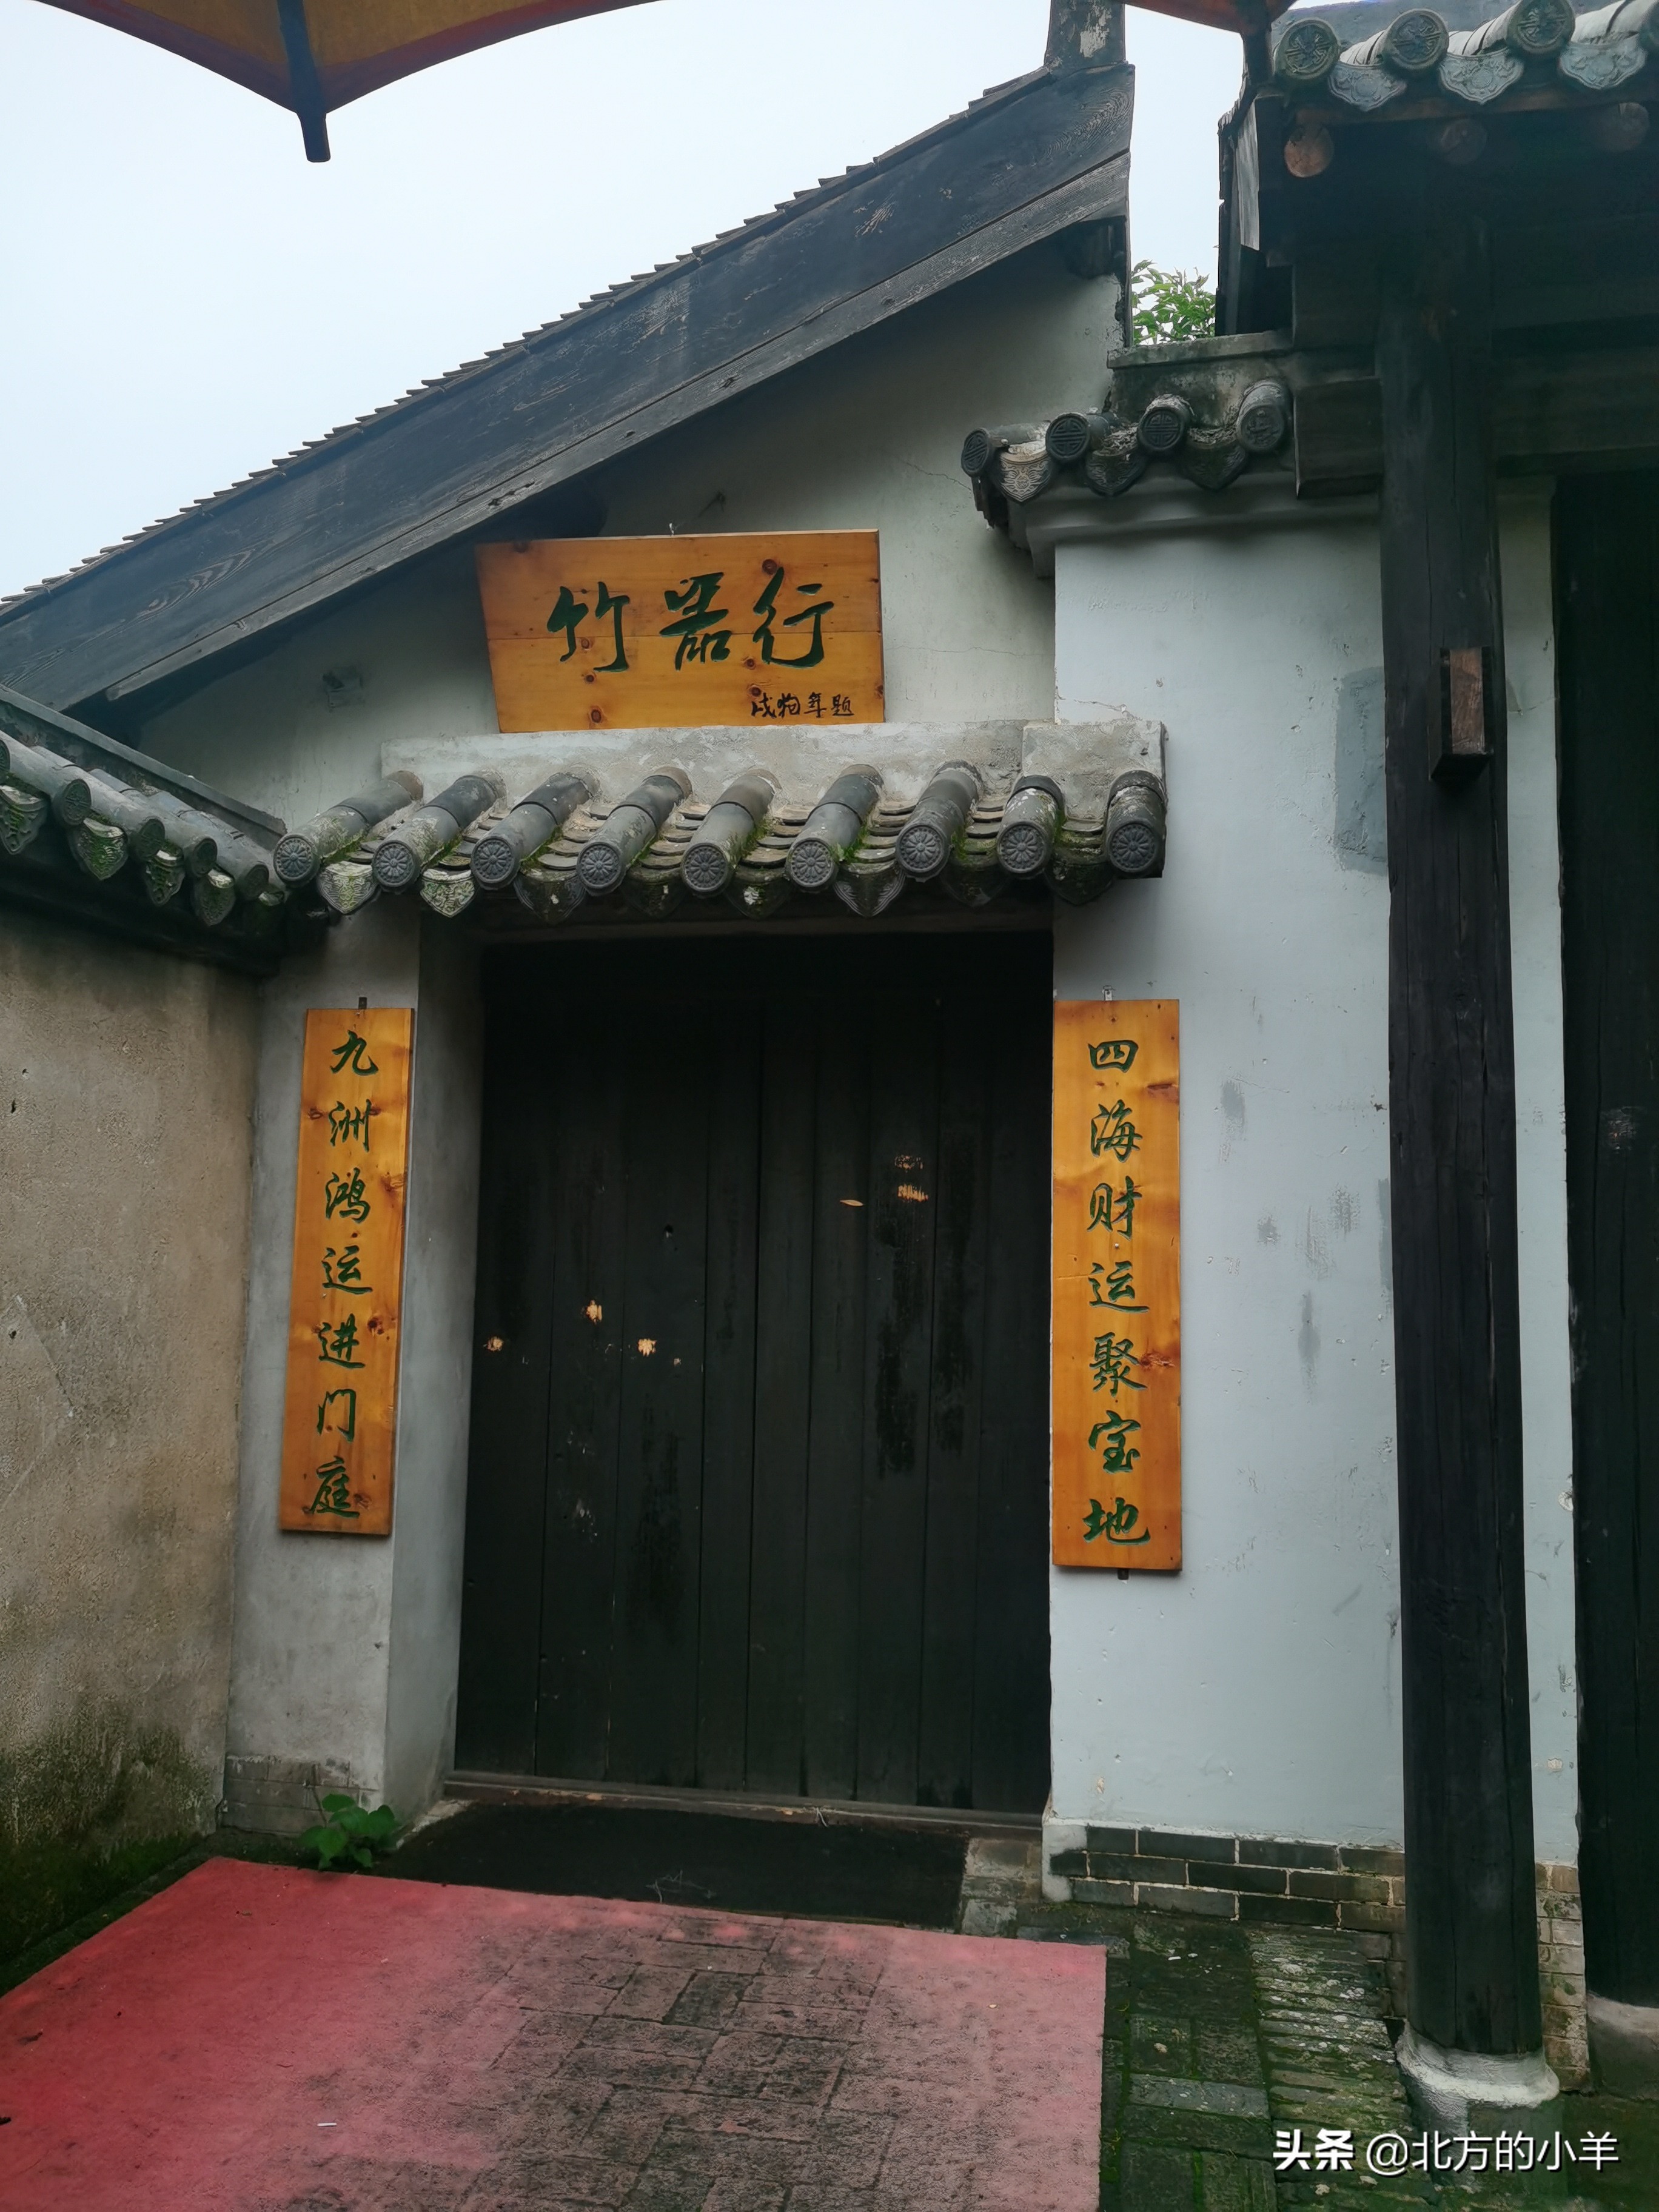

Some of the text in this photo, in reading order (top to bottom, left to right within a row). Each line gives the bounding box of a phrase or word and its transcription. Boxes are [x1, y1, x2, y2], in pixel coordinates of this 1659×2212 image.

[546, 567, 835, 672] 竹器行
[308, 1030, 378, 1518] 九洲鸿运进门庭
[1082, 1039, 1150, 1546] 四海财运聚宝地
